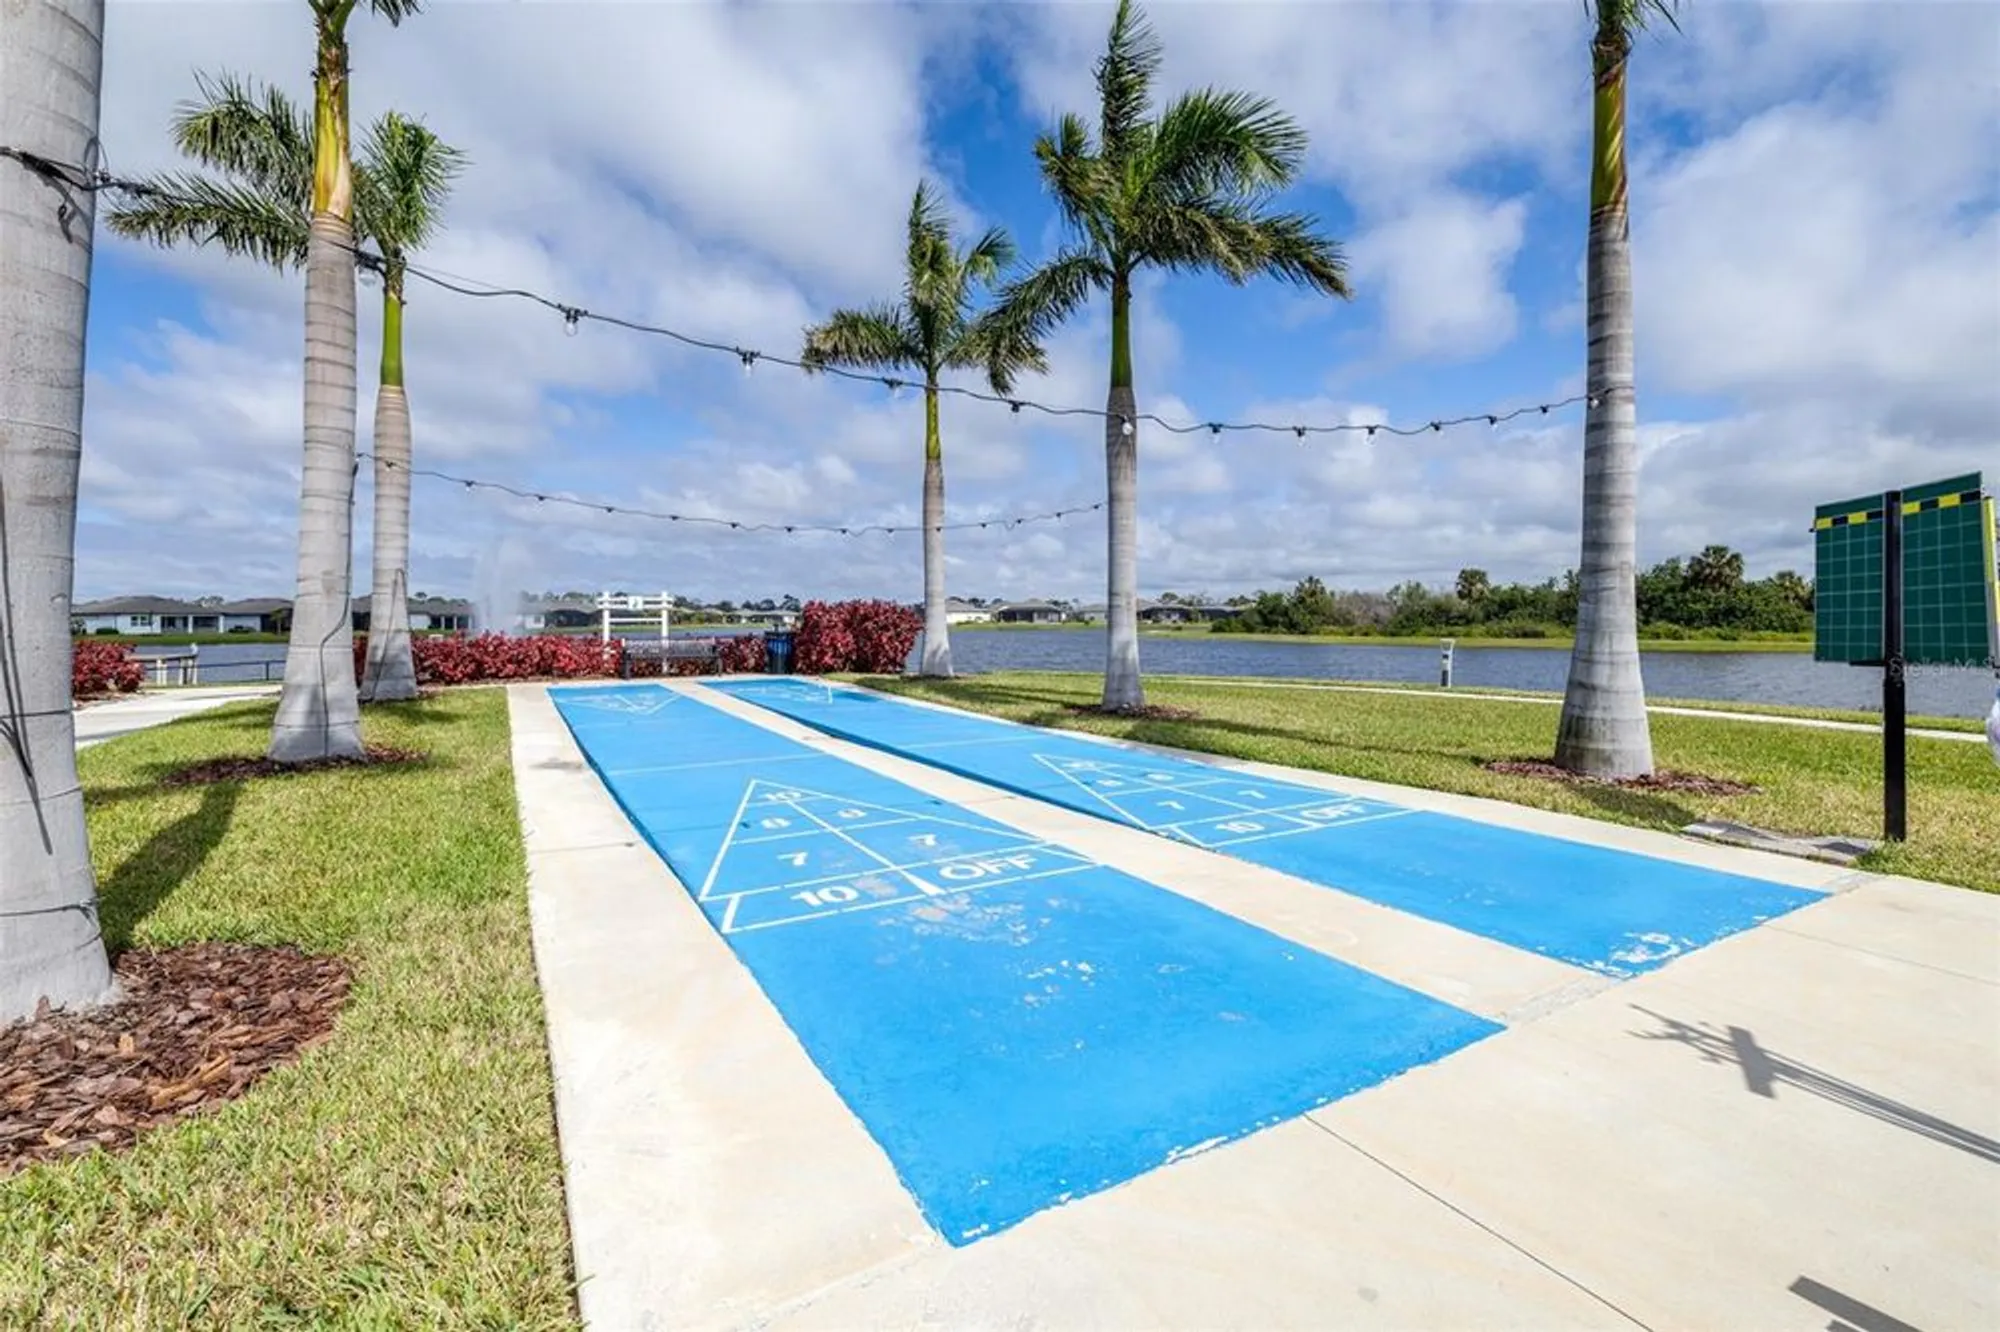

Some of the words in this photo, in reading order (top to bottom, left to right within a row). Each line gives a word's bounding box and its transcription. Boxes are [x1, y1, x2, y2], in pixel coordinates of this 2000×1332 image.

[1300, 803, 1366, 820] OFF
[907, 833, 938, 846] 7
[776, 851, 808, 866] 7
[938, 853, 1039, 880] OFF
[790, 885, 859, 906] 10
